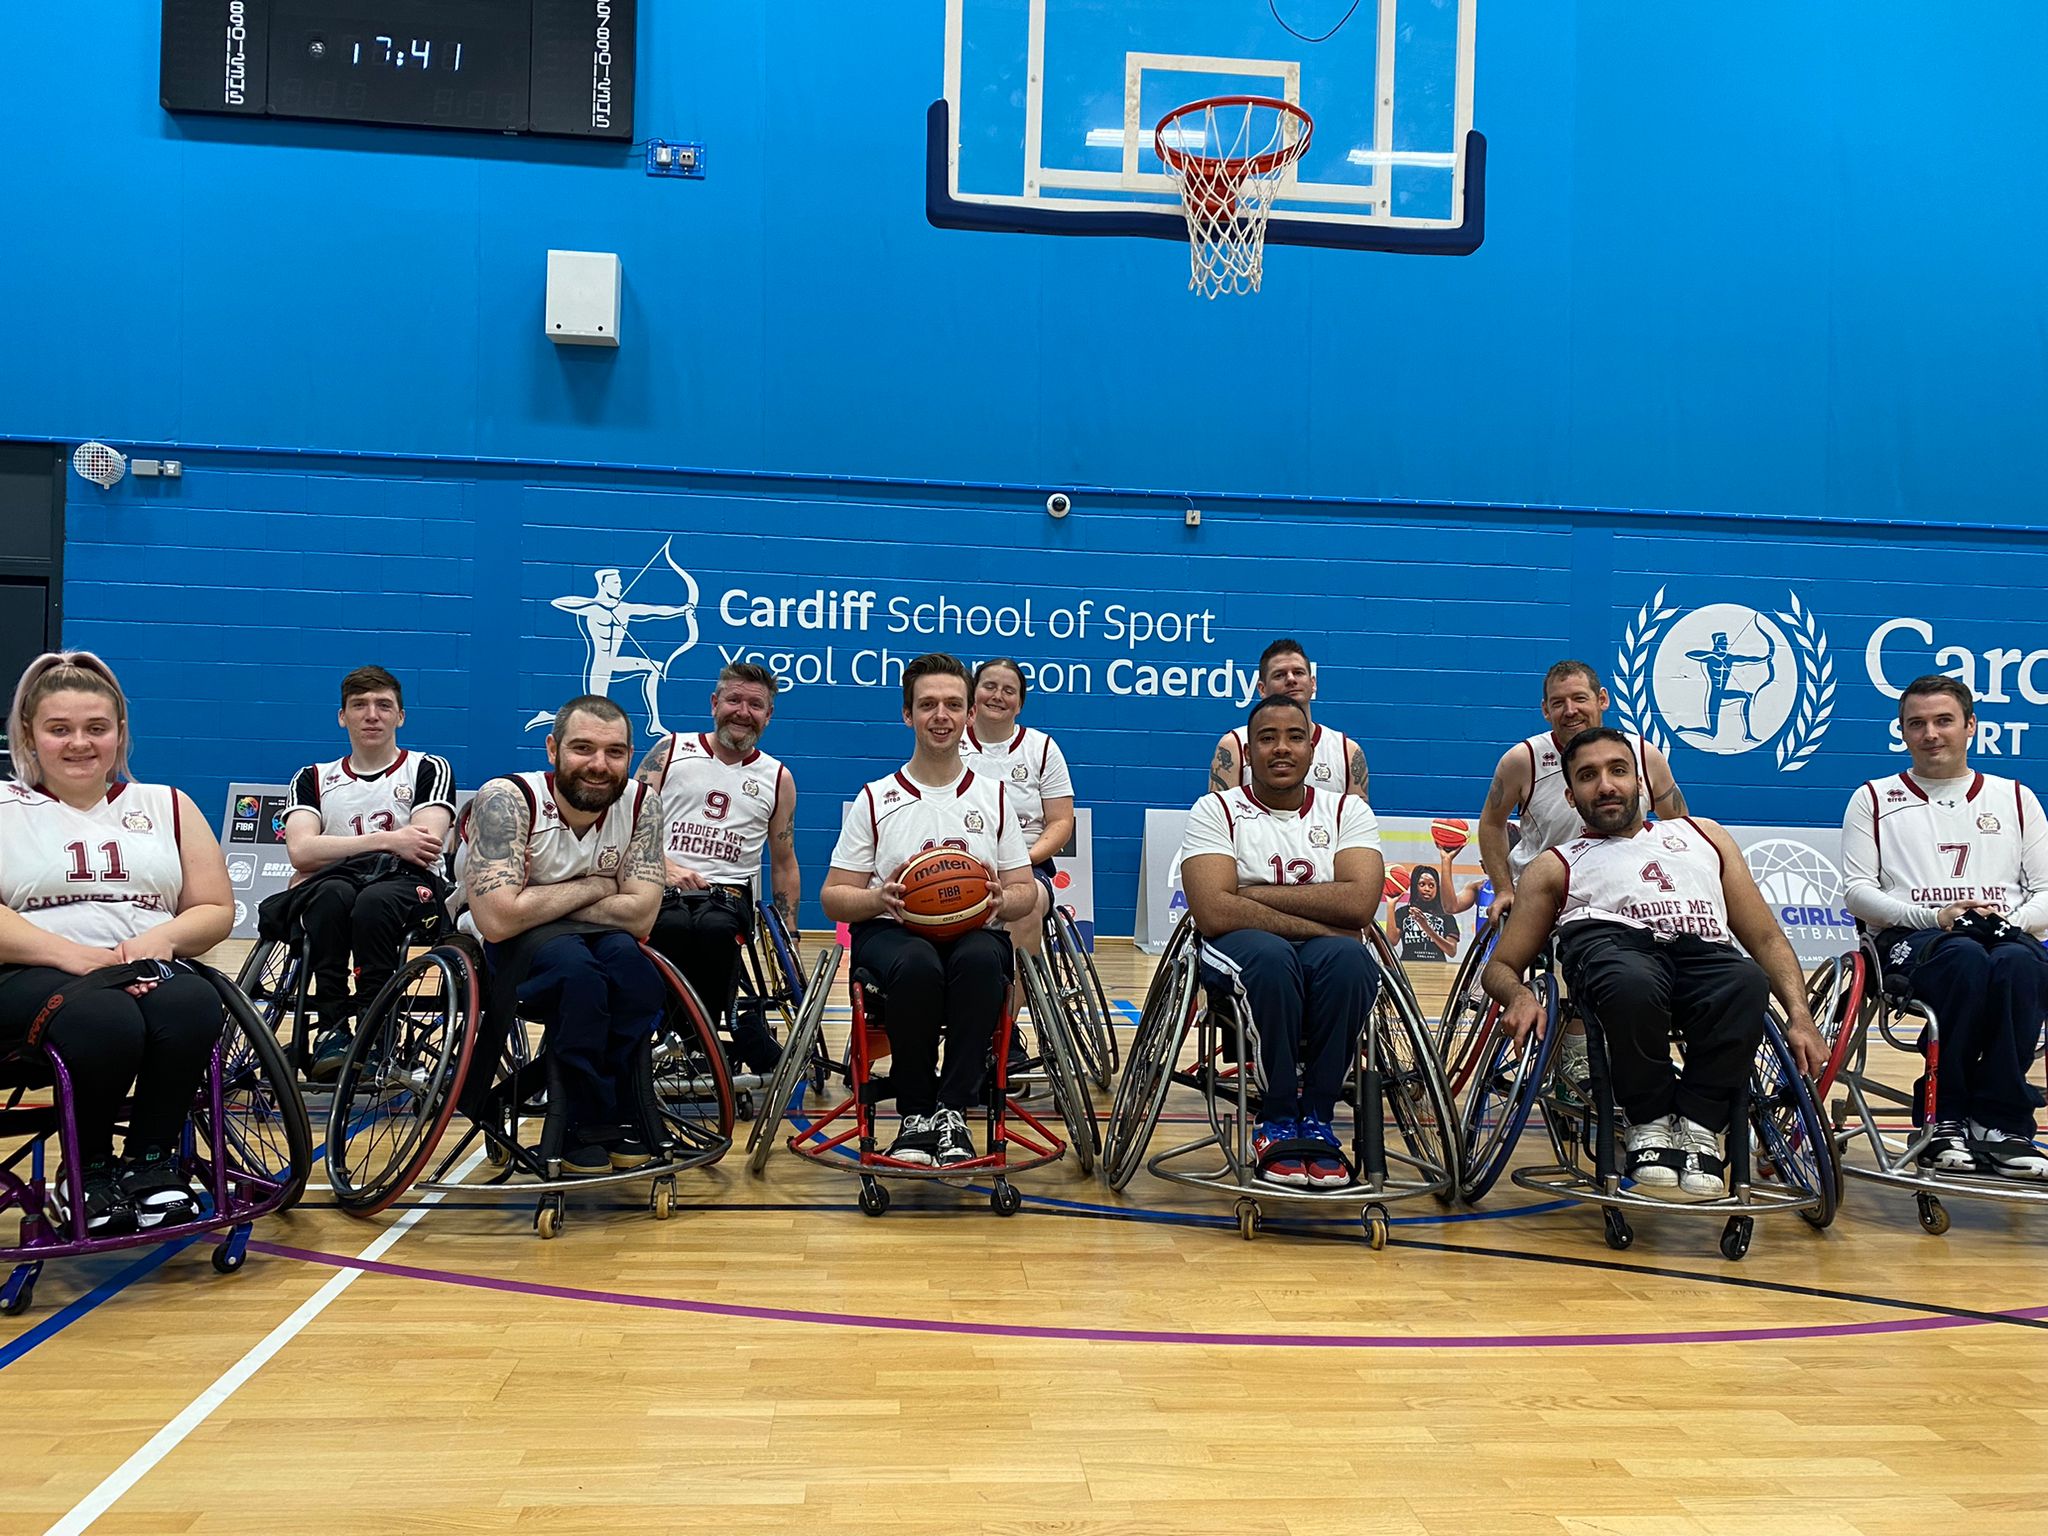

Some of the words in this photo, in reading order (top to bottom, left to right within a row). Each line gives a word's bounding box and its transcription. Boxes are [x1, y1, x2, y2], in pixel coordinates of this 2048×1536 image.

[719, 588, 877, 631] Cardiff
[887, 595, 1036, 638] School
[1048, 600, 1094, 639] of
[1103, 604, 1216, 649] Sport
[1106, 658, 1317, 708] Caerdy
[1888, 717, 2030, 755] SRT
[702, 789, 732, 822] 9
[235, 822, 254, 831] FIBA
[349, 809, 395, 836] 13
[671, 821, 720, 838] CARDIFF
[723, 829, 746, 847] MET
[64, 839, 130, 882] 11
[668, 835, 741, 863] ARCHERS
[1937, 842, 1971, 878] 7
[914, 859, 972, 881] molten
[1268, 853, 1316, 886] 12
[1639, 860, 1675, 892] 4
[938, 885, 961, 899] FIBA
[1911, 887, 1975, 902] CARDIFF
[1621, 900, 1682, 919] CARDIFF
[1687, 899, 1715, 915] MET
[1781, 906, 1856, 927] GIRLS
[1783, 926, 1860, 941] ETBALL
